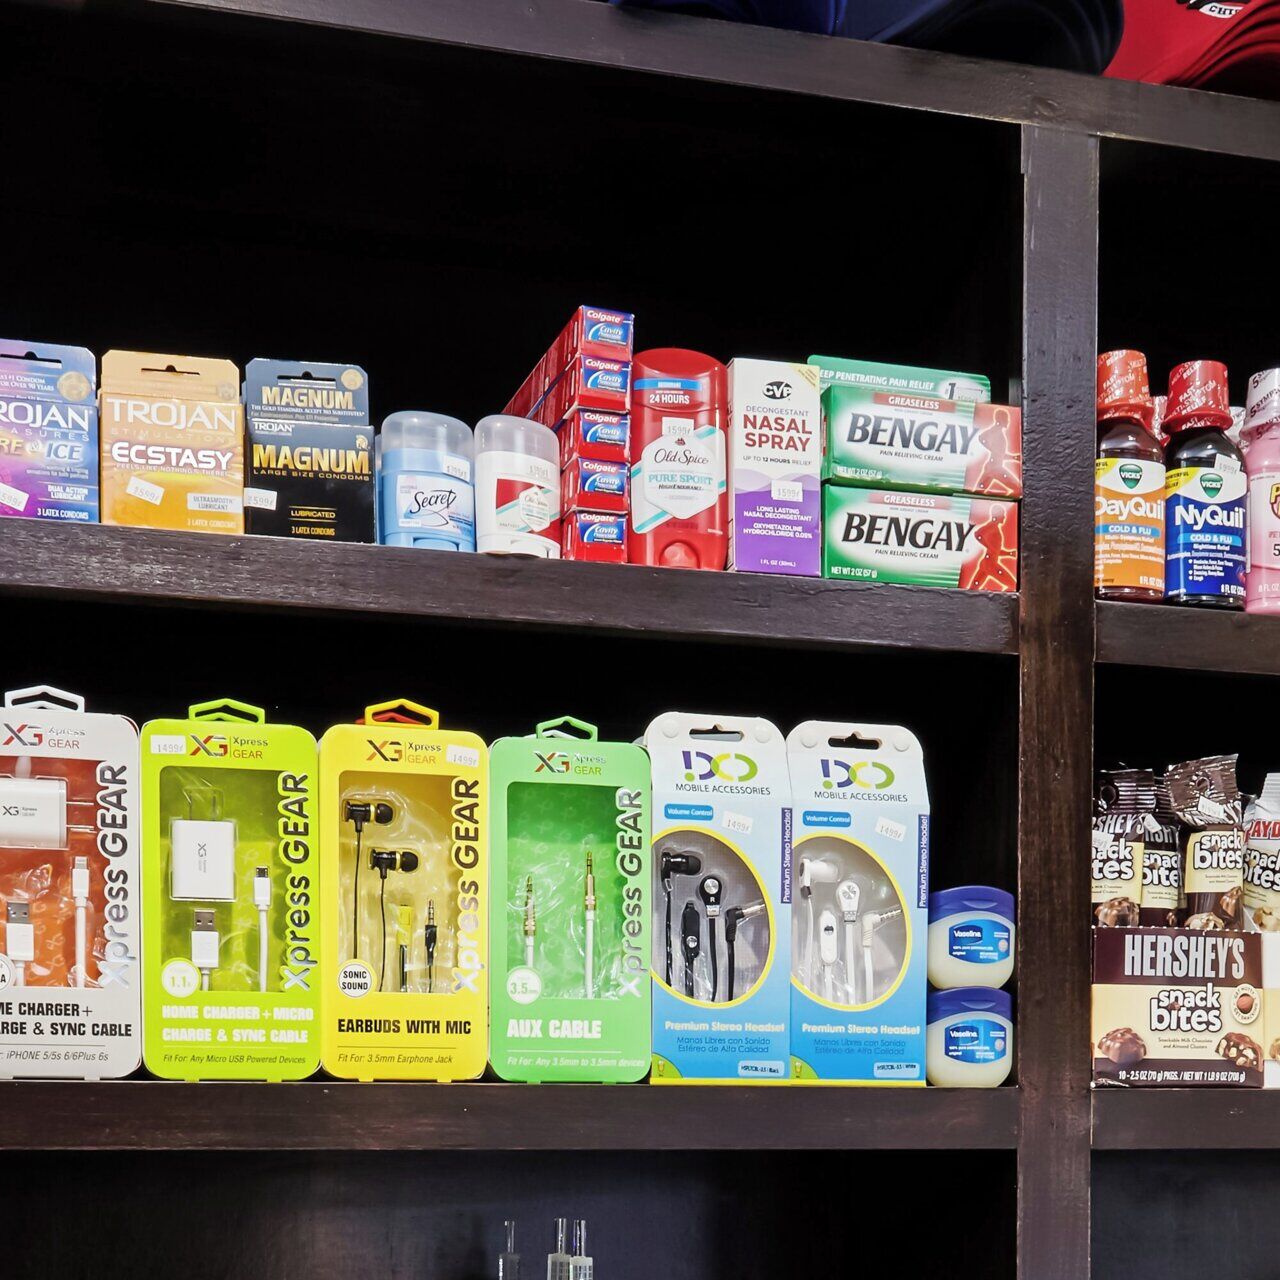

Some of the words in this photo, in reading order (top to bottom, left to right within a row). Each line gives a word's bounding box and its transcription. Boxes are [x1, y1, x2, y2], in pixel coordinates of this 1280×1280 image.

[587, 310, 621, 323] Colgate
[262, 386, 354, 409] MAGNUM
[649, 393, 663, 403] 24
[665, 394, 689, 404] HOURS
[107, 398, 236, 433] TROJAN
[746, 405, 809, 416] DECONGESTANT
[743, 415, 812, 435] NASAL
[745, 432, 810, 452] SPRAY
[847, 413, 980, 455] BENGAY
[111, 442, 233, 469] ECSTASY
[253, 444, 371, 474] MAGNUM
[648, 473, 679, 484] PURE
[681, 475, 713, 485] SPORT
[1120, 471, 1142, 480] VICKS
[413, 489, 456, 514] Secret
[884, 495, 935, 507] GREASELESS
[291, 510, 336, 518] LUBRICATED
[580, 513, 615, 523] Colgate
[1175, 505, 1244, 530] NyQuil
[842, 512, 975, 552] BENGAY
[48, 739, 80, 749] GEAR
[675, 784, 709, 795] MOBILE
[712, 785, 771, 796] ACCESSORIES
[814, 791, 847, 801] MOBILE
[850, 791, 908, 803] ACCESSORIES
[99, 765, 129, 857] GEAR
[98, 868, 136, 989] Xpress
[1124, 934, 1245, 980] HERSHEY'S
[343, 970, 367, 979] SONIC
[342, 980, 368, 991] SOUND
[1150, 1001, 1222, 1032] bites
[33, 1022, 44, 1035] &
[50, 1022, 87, 1036] SYNC
[91, 1023, 132, 1037] CABLE
[338, 1019, 401, 1034] EARBUDS
[406, 1020, 441, 1034] WITH
[446, 1020, 471, 1035] MIC
[507, 1020, 544, 1039] AUX
[549, 1020, 602, 1039] CABLE
[665, 1021, 704, 1032] Premium
[706, 1022, 739, 1033] Stereo
[741, 1022, 785, 1033] Headset
